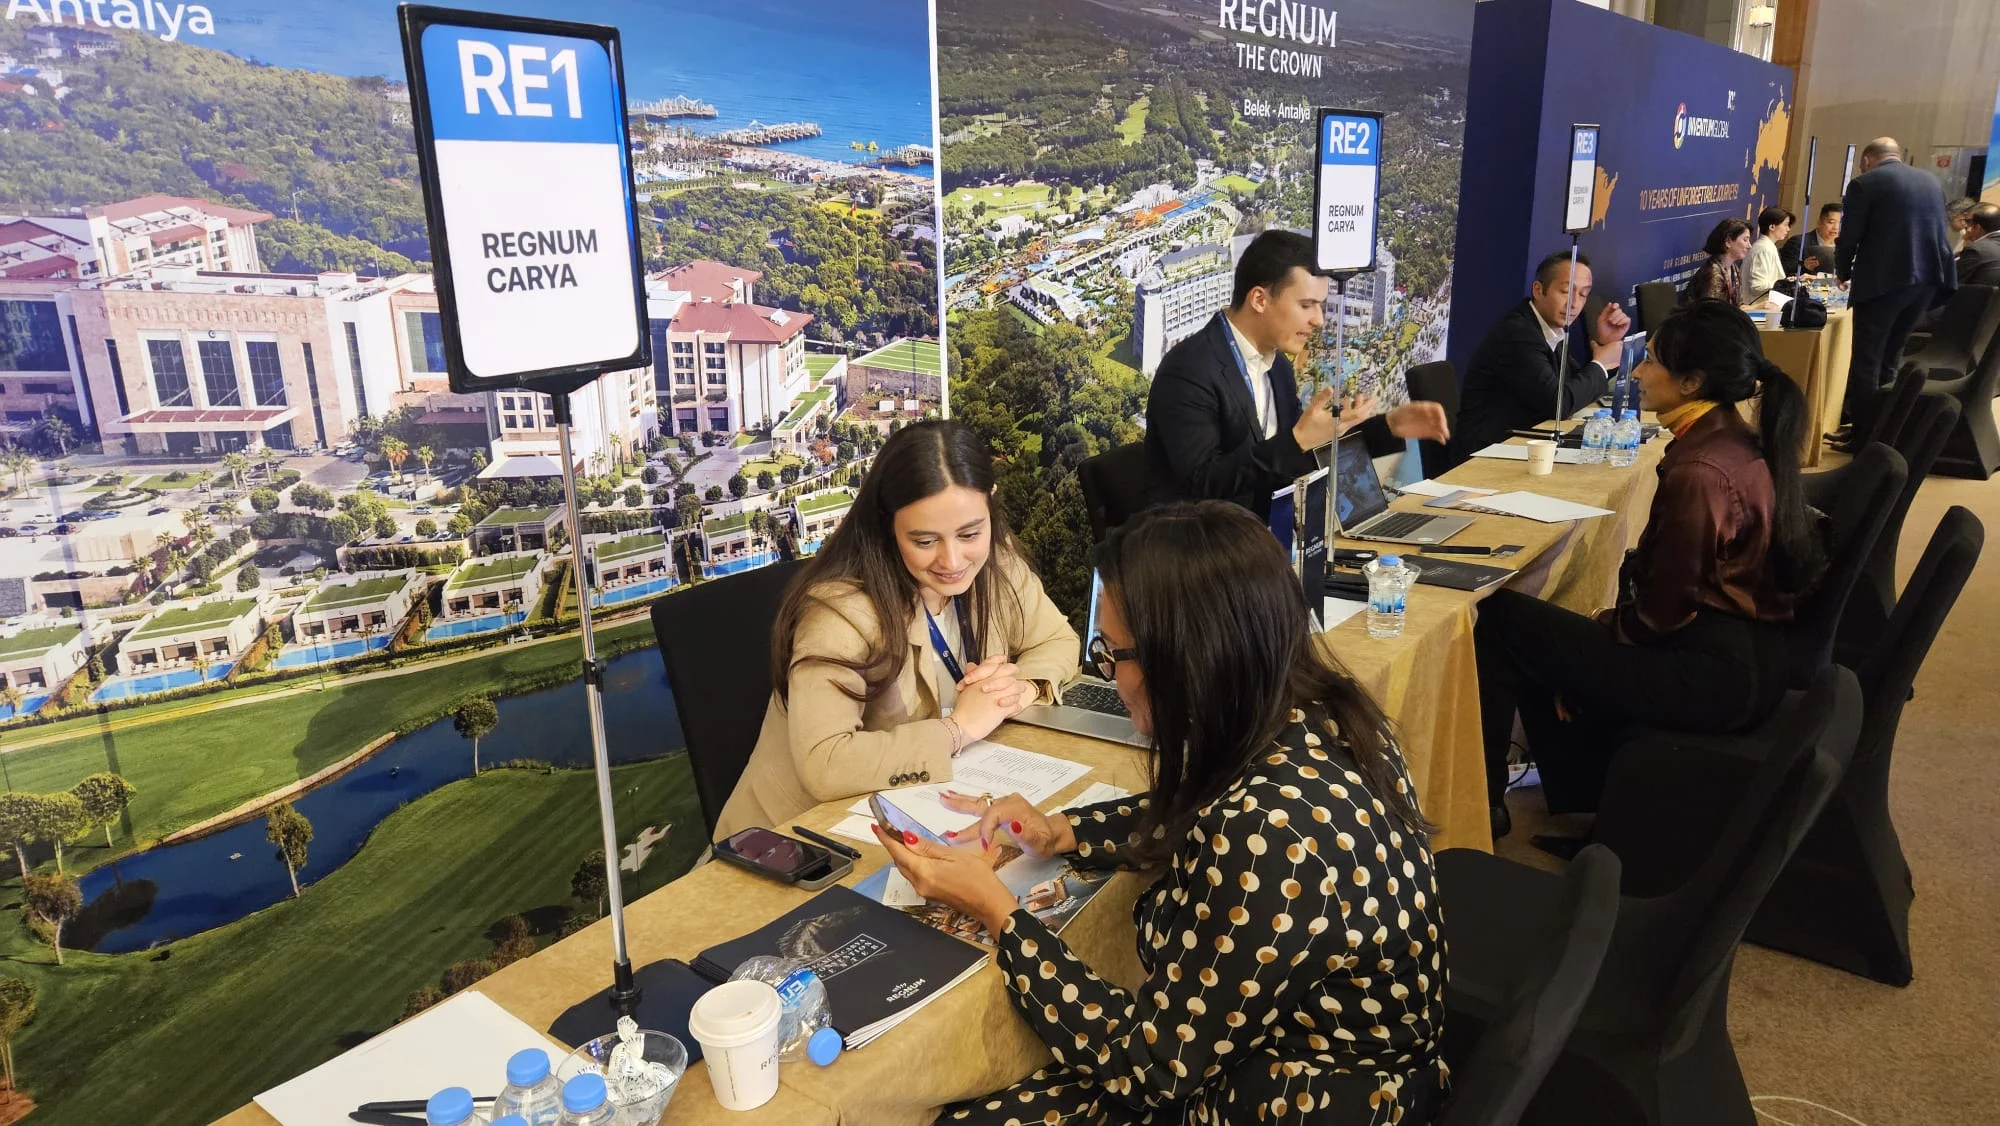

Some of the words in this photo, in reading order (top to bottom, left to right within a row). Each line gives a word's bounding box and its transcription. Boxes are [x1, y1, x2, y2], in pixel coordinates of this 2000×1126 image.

[5, 0, 215, 42] Antalya
[1219, 0, 1338, 48] REGNUM
[1236, 42, 1266, 71] THE
[1270, 48, 1322, 78] CROWN
[457, 39, 583, 119] RE1
[1243, 98, 1271, 117] Belek
[1277, 102, 1311, 123] Antalya
[1329, 120, 1370, 155] RE2
[1576, 132, 1594, 154] RE3
[1328, 205, 1364, 217] REGNUM
[1640, 189, 1648, 211] 10
[1648, 188, 1669, 210] YEARS
[1668, 187, 1678, 207] OF
[1327, 219, 1356, 233] CARYA
[482, 229, 598, 258] REGNUM
[487, 263, 578, 294] CARYA
[886, 978, 926, 1003] REGNUM
